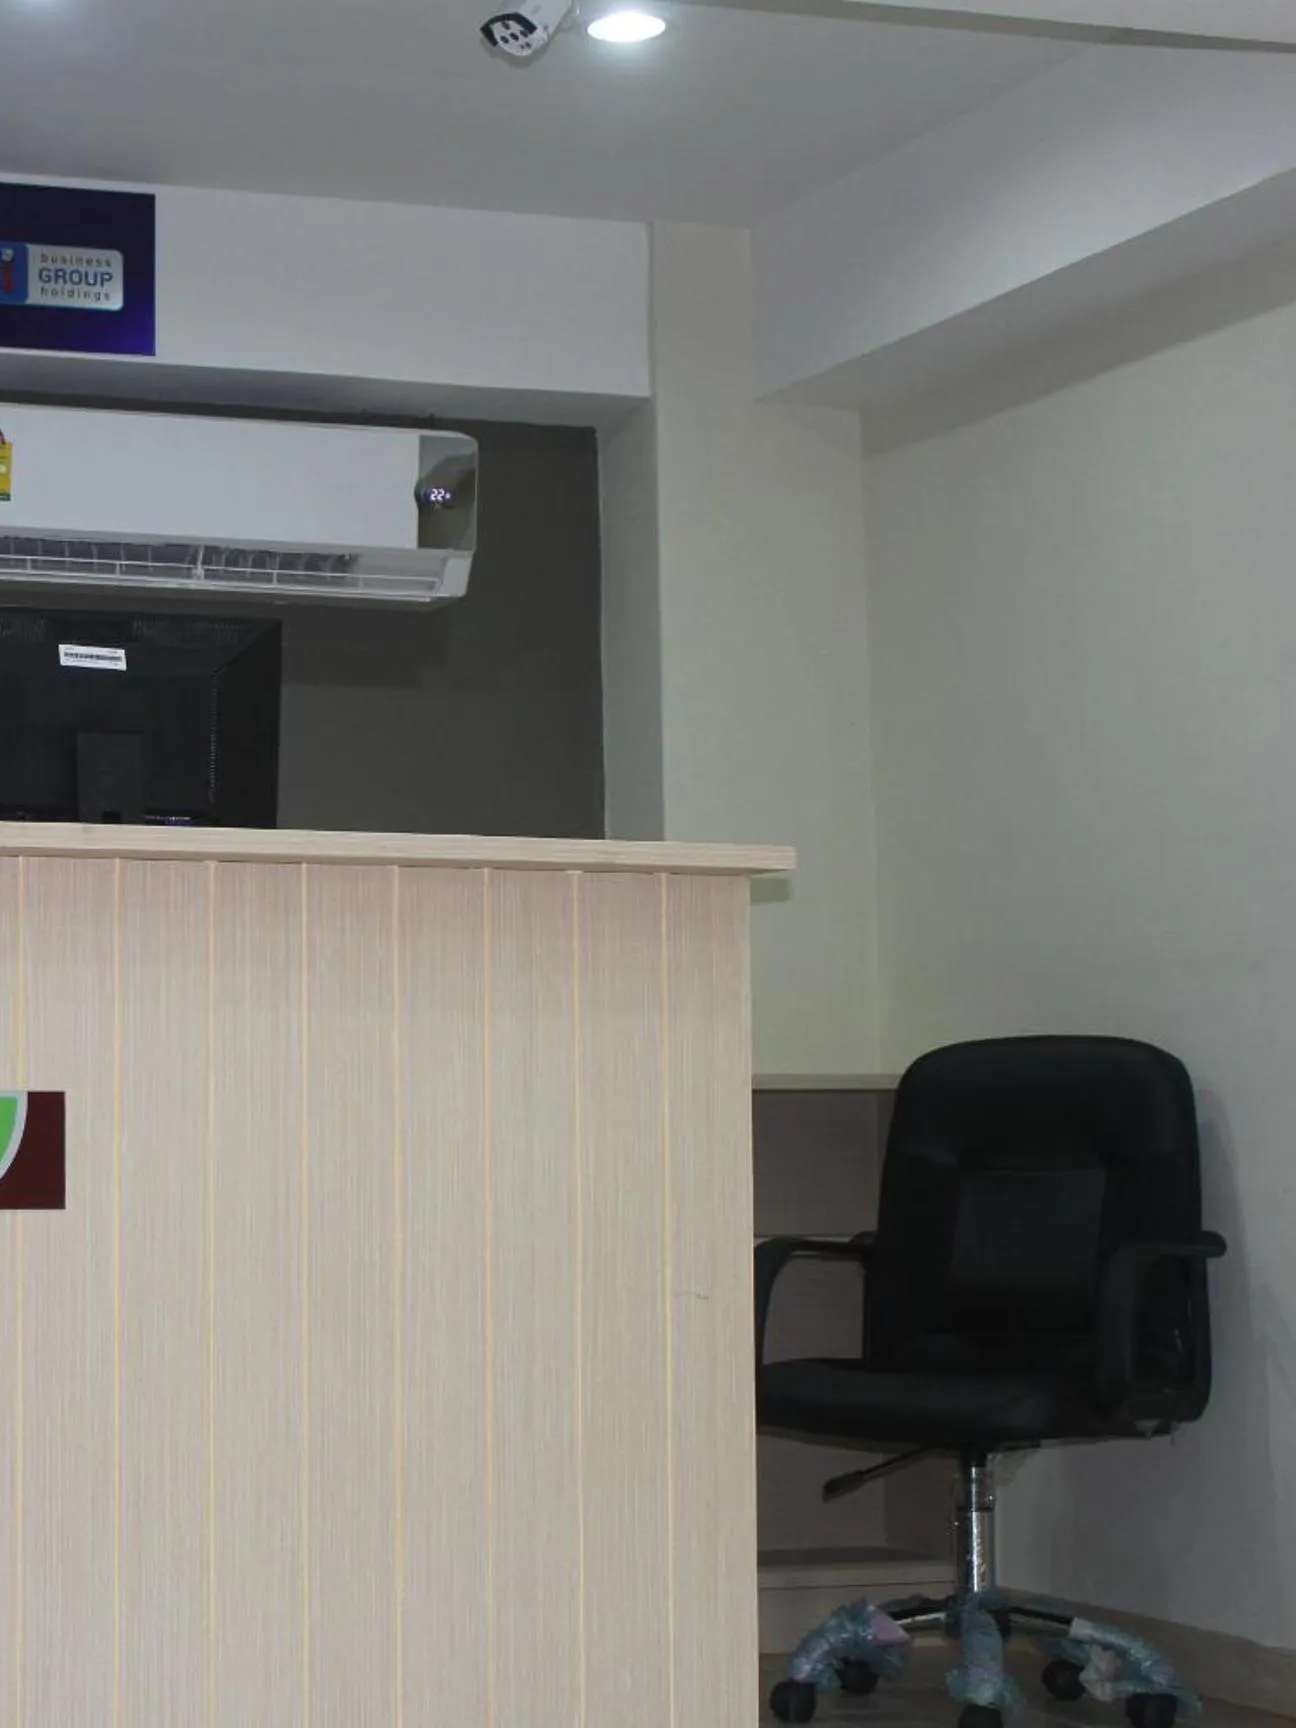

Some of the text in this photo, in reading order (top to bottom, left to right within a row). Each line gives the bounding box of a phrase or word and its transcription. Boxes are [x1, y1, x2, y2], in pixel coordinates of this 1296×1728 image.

[40, 252, 112, 268] business
[38, 267, 114, 288] GROUP
[40, 286, 111, 302] holdings
